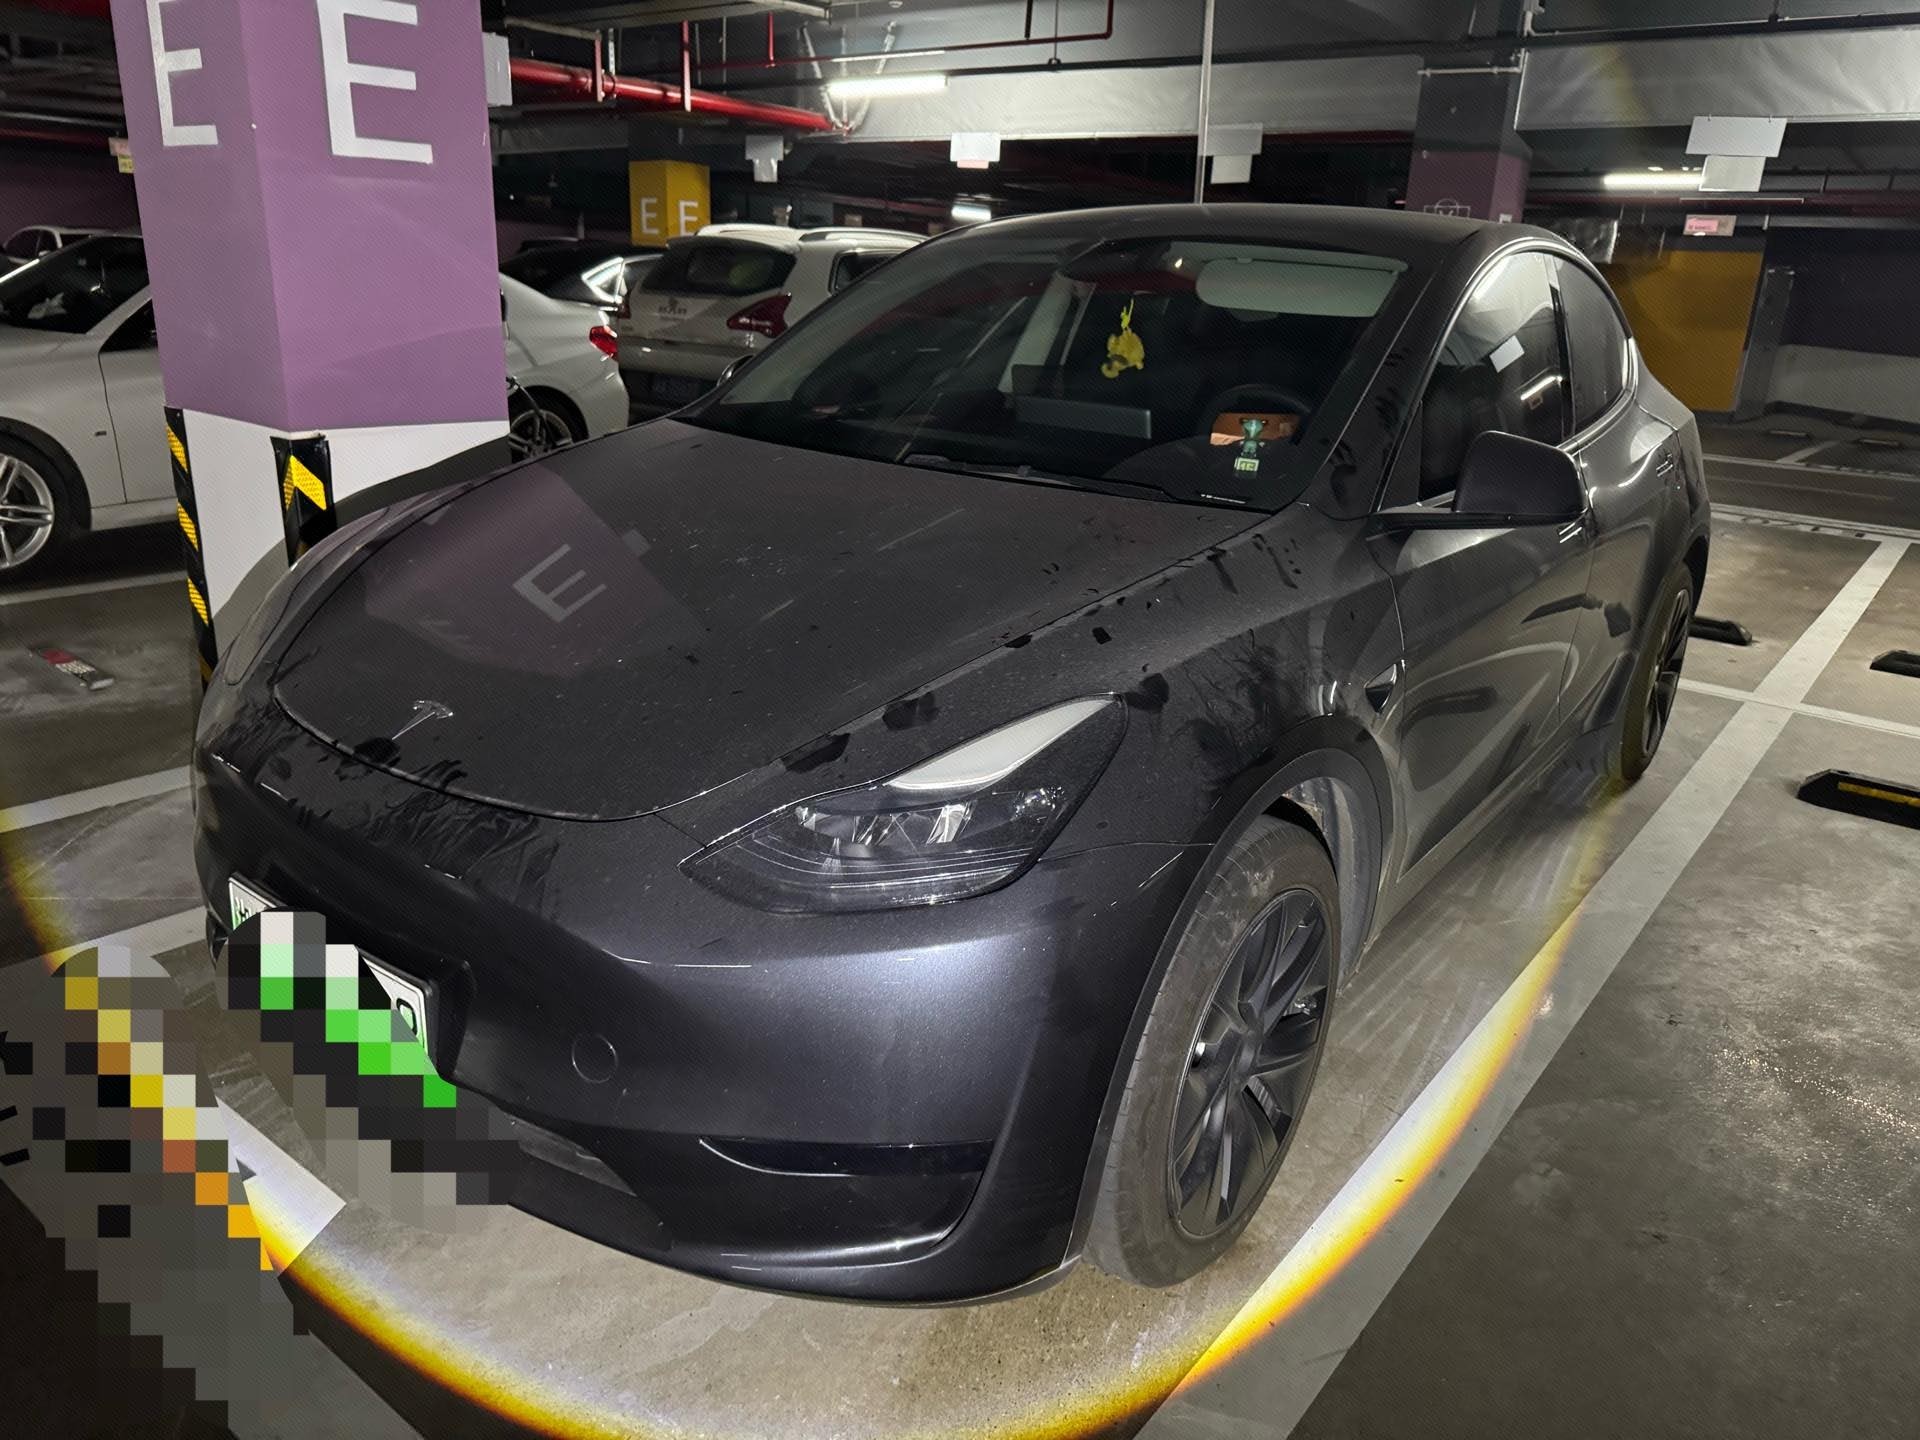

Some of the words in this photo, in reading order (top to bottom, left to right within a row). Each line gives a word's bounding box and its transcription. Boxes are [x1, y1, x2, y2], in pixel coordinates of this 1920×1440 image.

[146, 0, 218, 146] E
[317, 0, 433, 164] E
[641, 197, 659, 234] E
[679, 200, 699, 237] E
